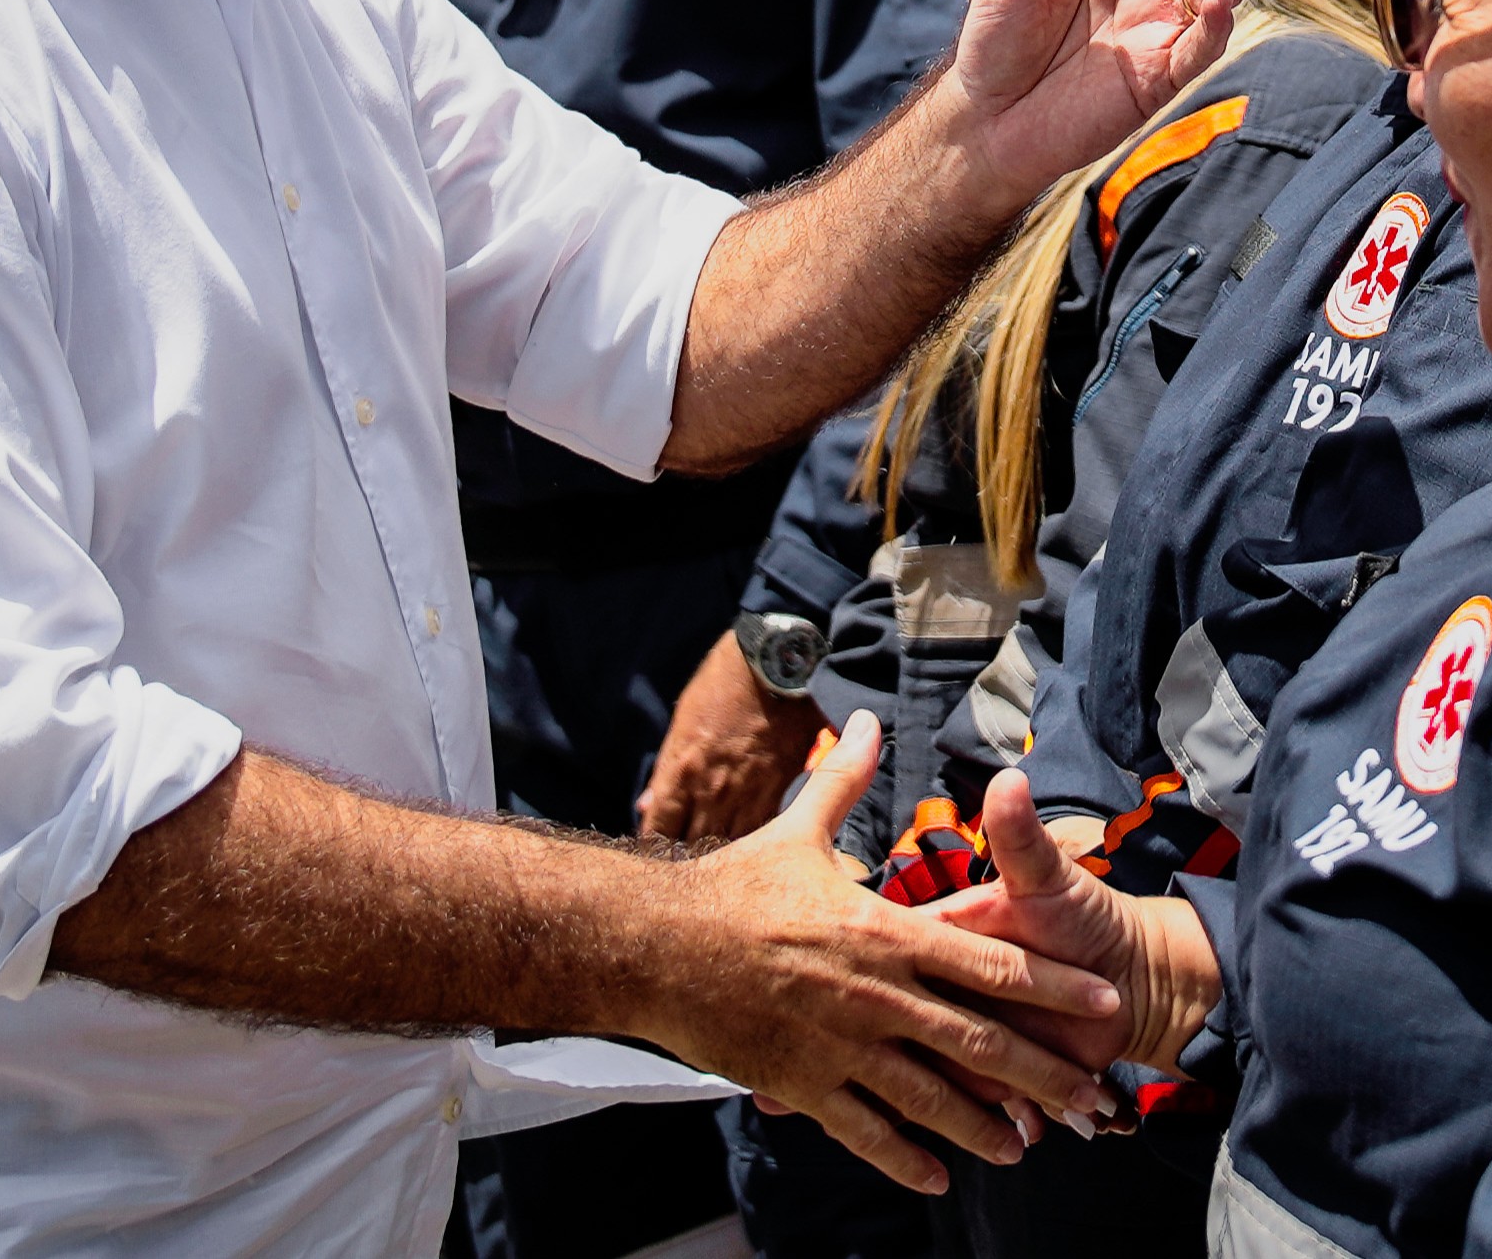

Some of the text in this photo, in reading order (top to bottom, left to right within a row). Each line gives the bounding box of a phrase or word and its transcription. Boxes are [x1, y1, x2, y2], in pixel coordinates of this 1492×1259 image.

[1282, 377, 1363, 433] 192
[1336, 747, 1439, 852] SAMU
[1293, 803, 1370, 878] 192
